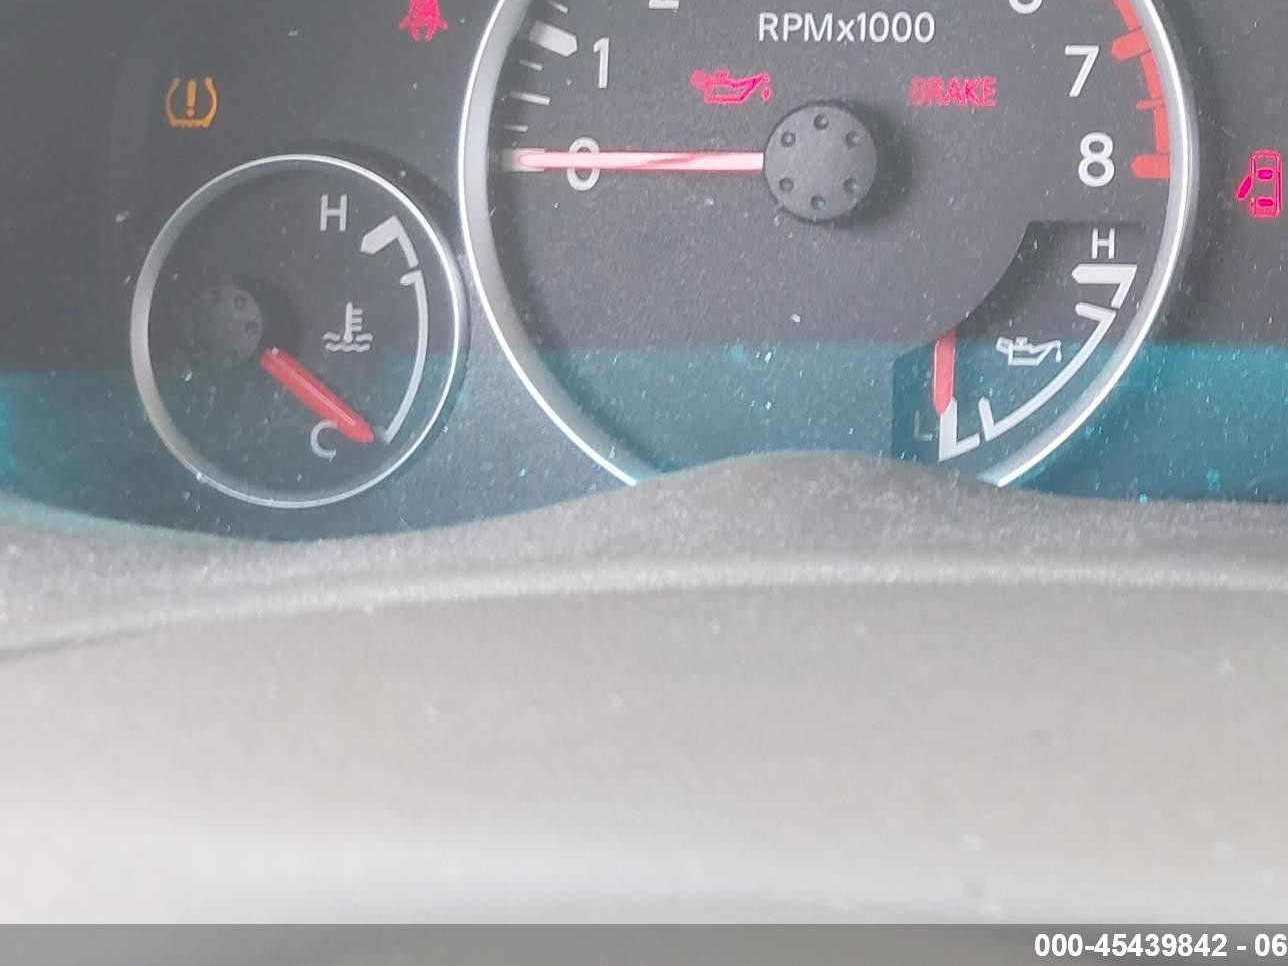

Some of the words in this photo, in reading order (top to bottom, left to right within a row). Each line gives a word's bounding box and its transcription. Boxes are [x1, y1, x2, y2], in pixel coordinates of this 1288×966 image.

[758, 12, 935, 44] RPMx1000
[593, 39, 609, 89] 1
[1065, 45, 1101, 97] 7
[910, 76, 997, 107] BRAKE
[1078, 133, 1115, 187] 8
[319, 194, 348, 232] H
[1091, 230, 1116, 260] H
